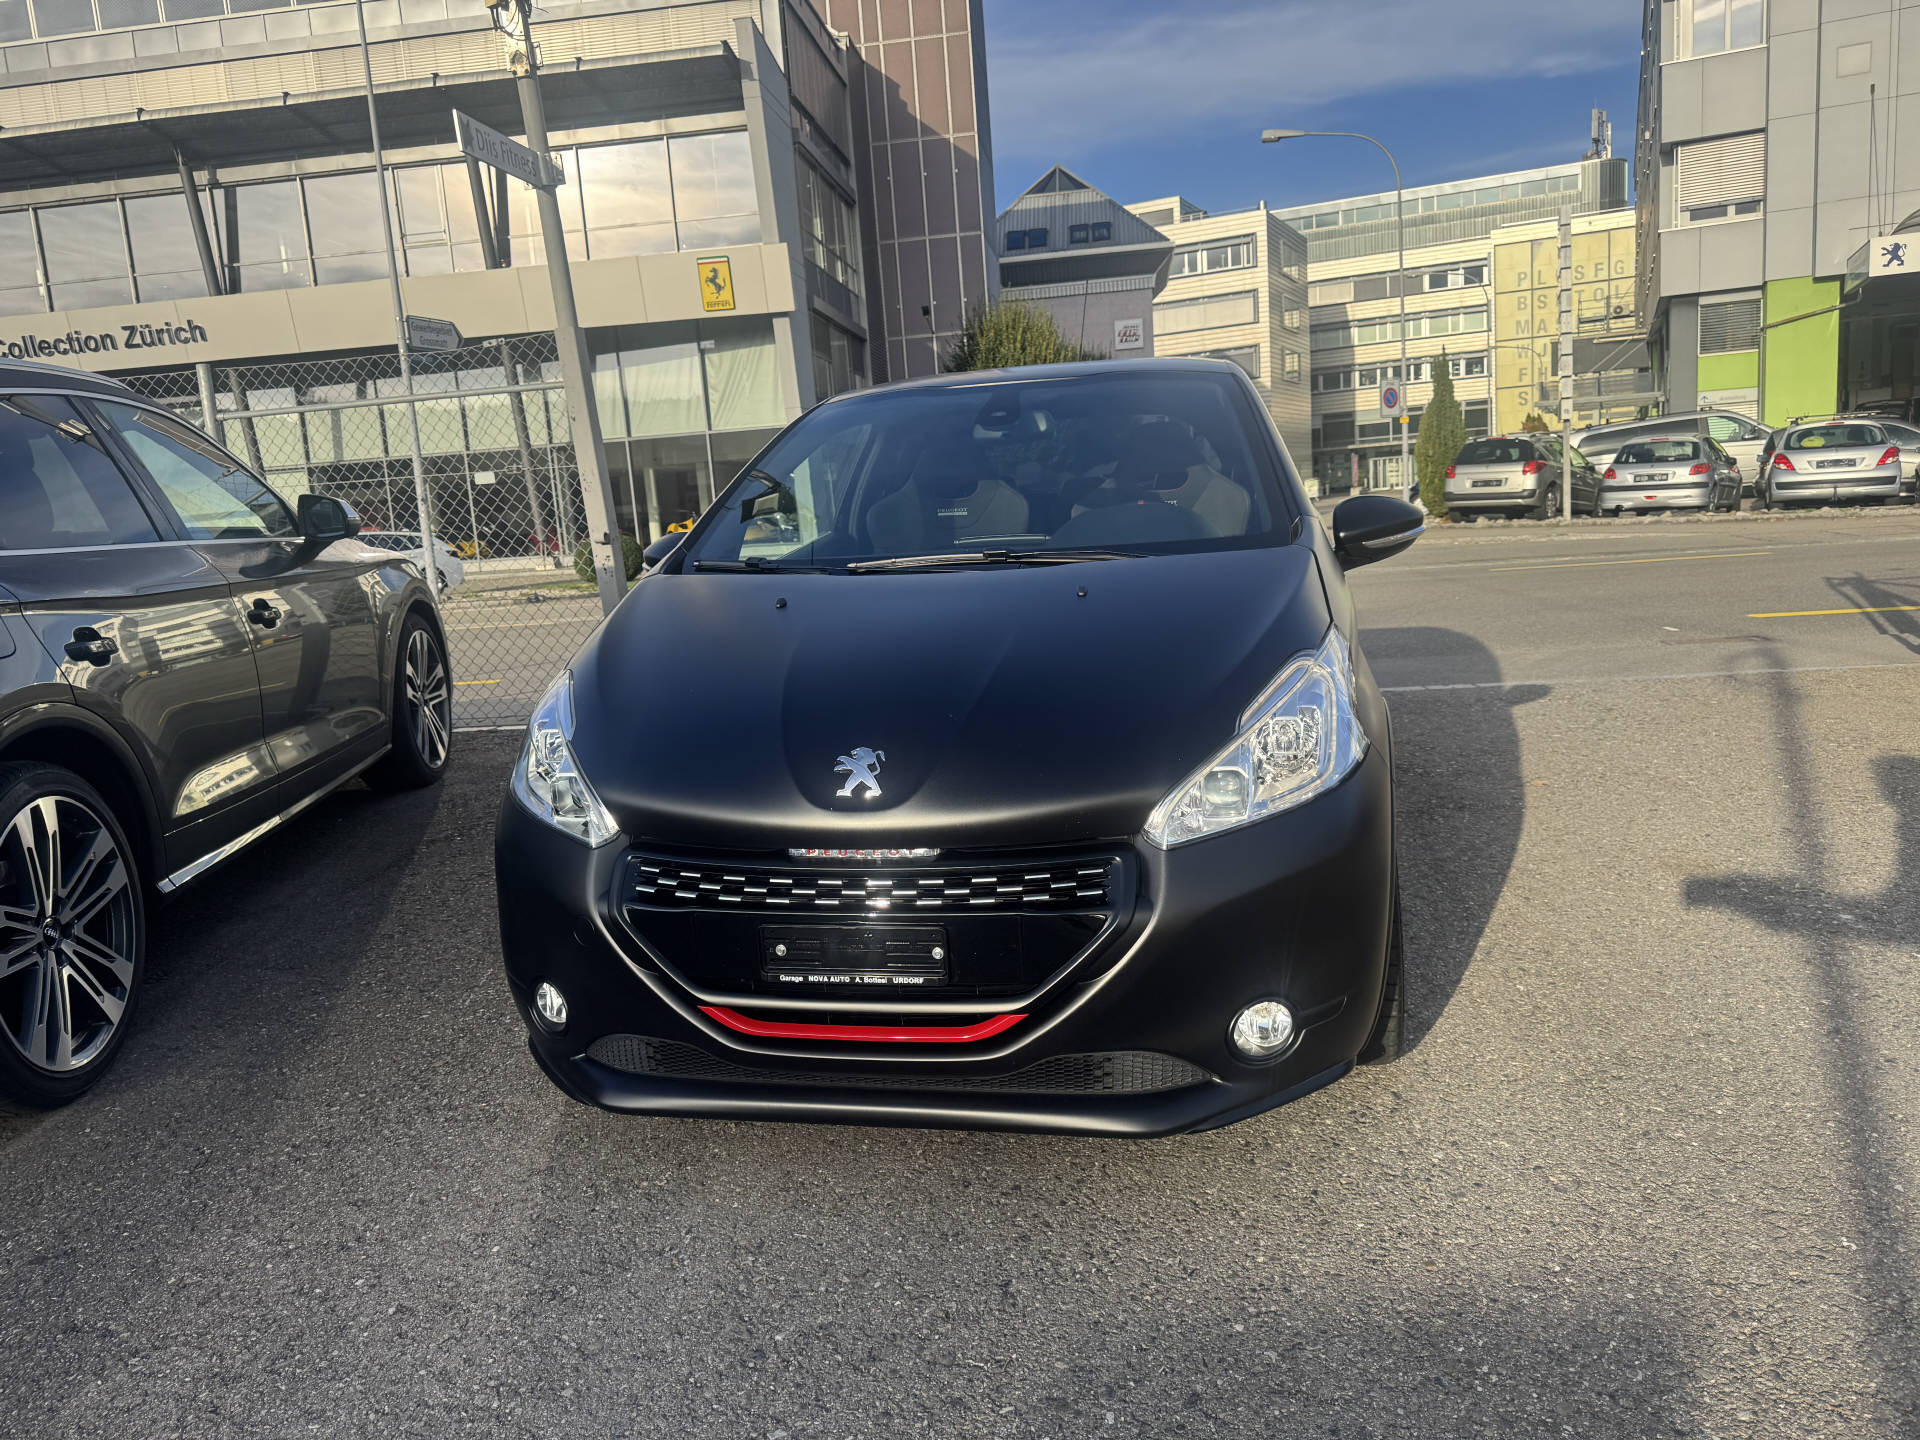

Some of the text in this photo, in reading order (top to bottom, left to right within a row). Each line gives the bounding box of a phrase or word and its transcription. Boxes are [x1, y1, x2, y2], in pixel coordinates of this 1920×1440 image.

[500, 140, 537, 177] Fitness
[121, 319, 208, 349] Zürich
[779, 974, 804, 983] Garage
[808, 975, 829, 983] NOVA
[830, 975, 850, 983] AUTO
[855, 975, 863, 983] A.
[892, 976, 924, 984] URDORF
